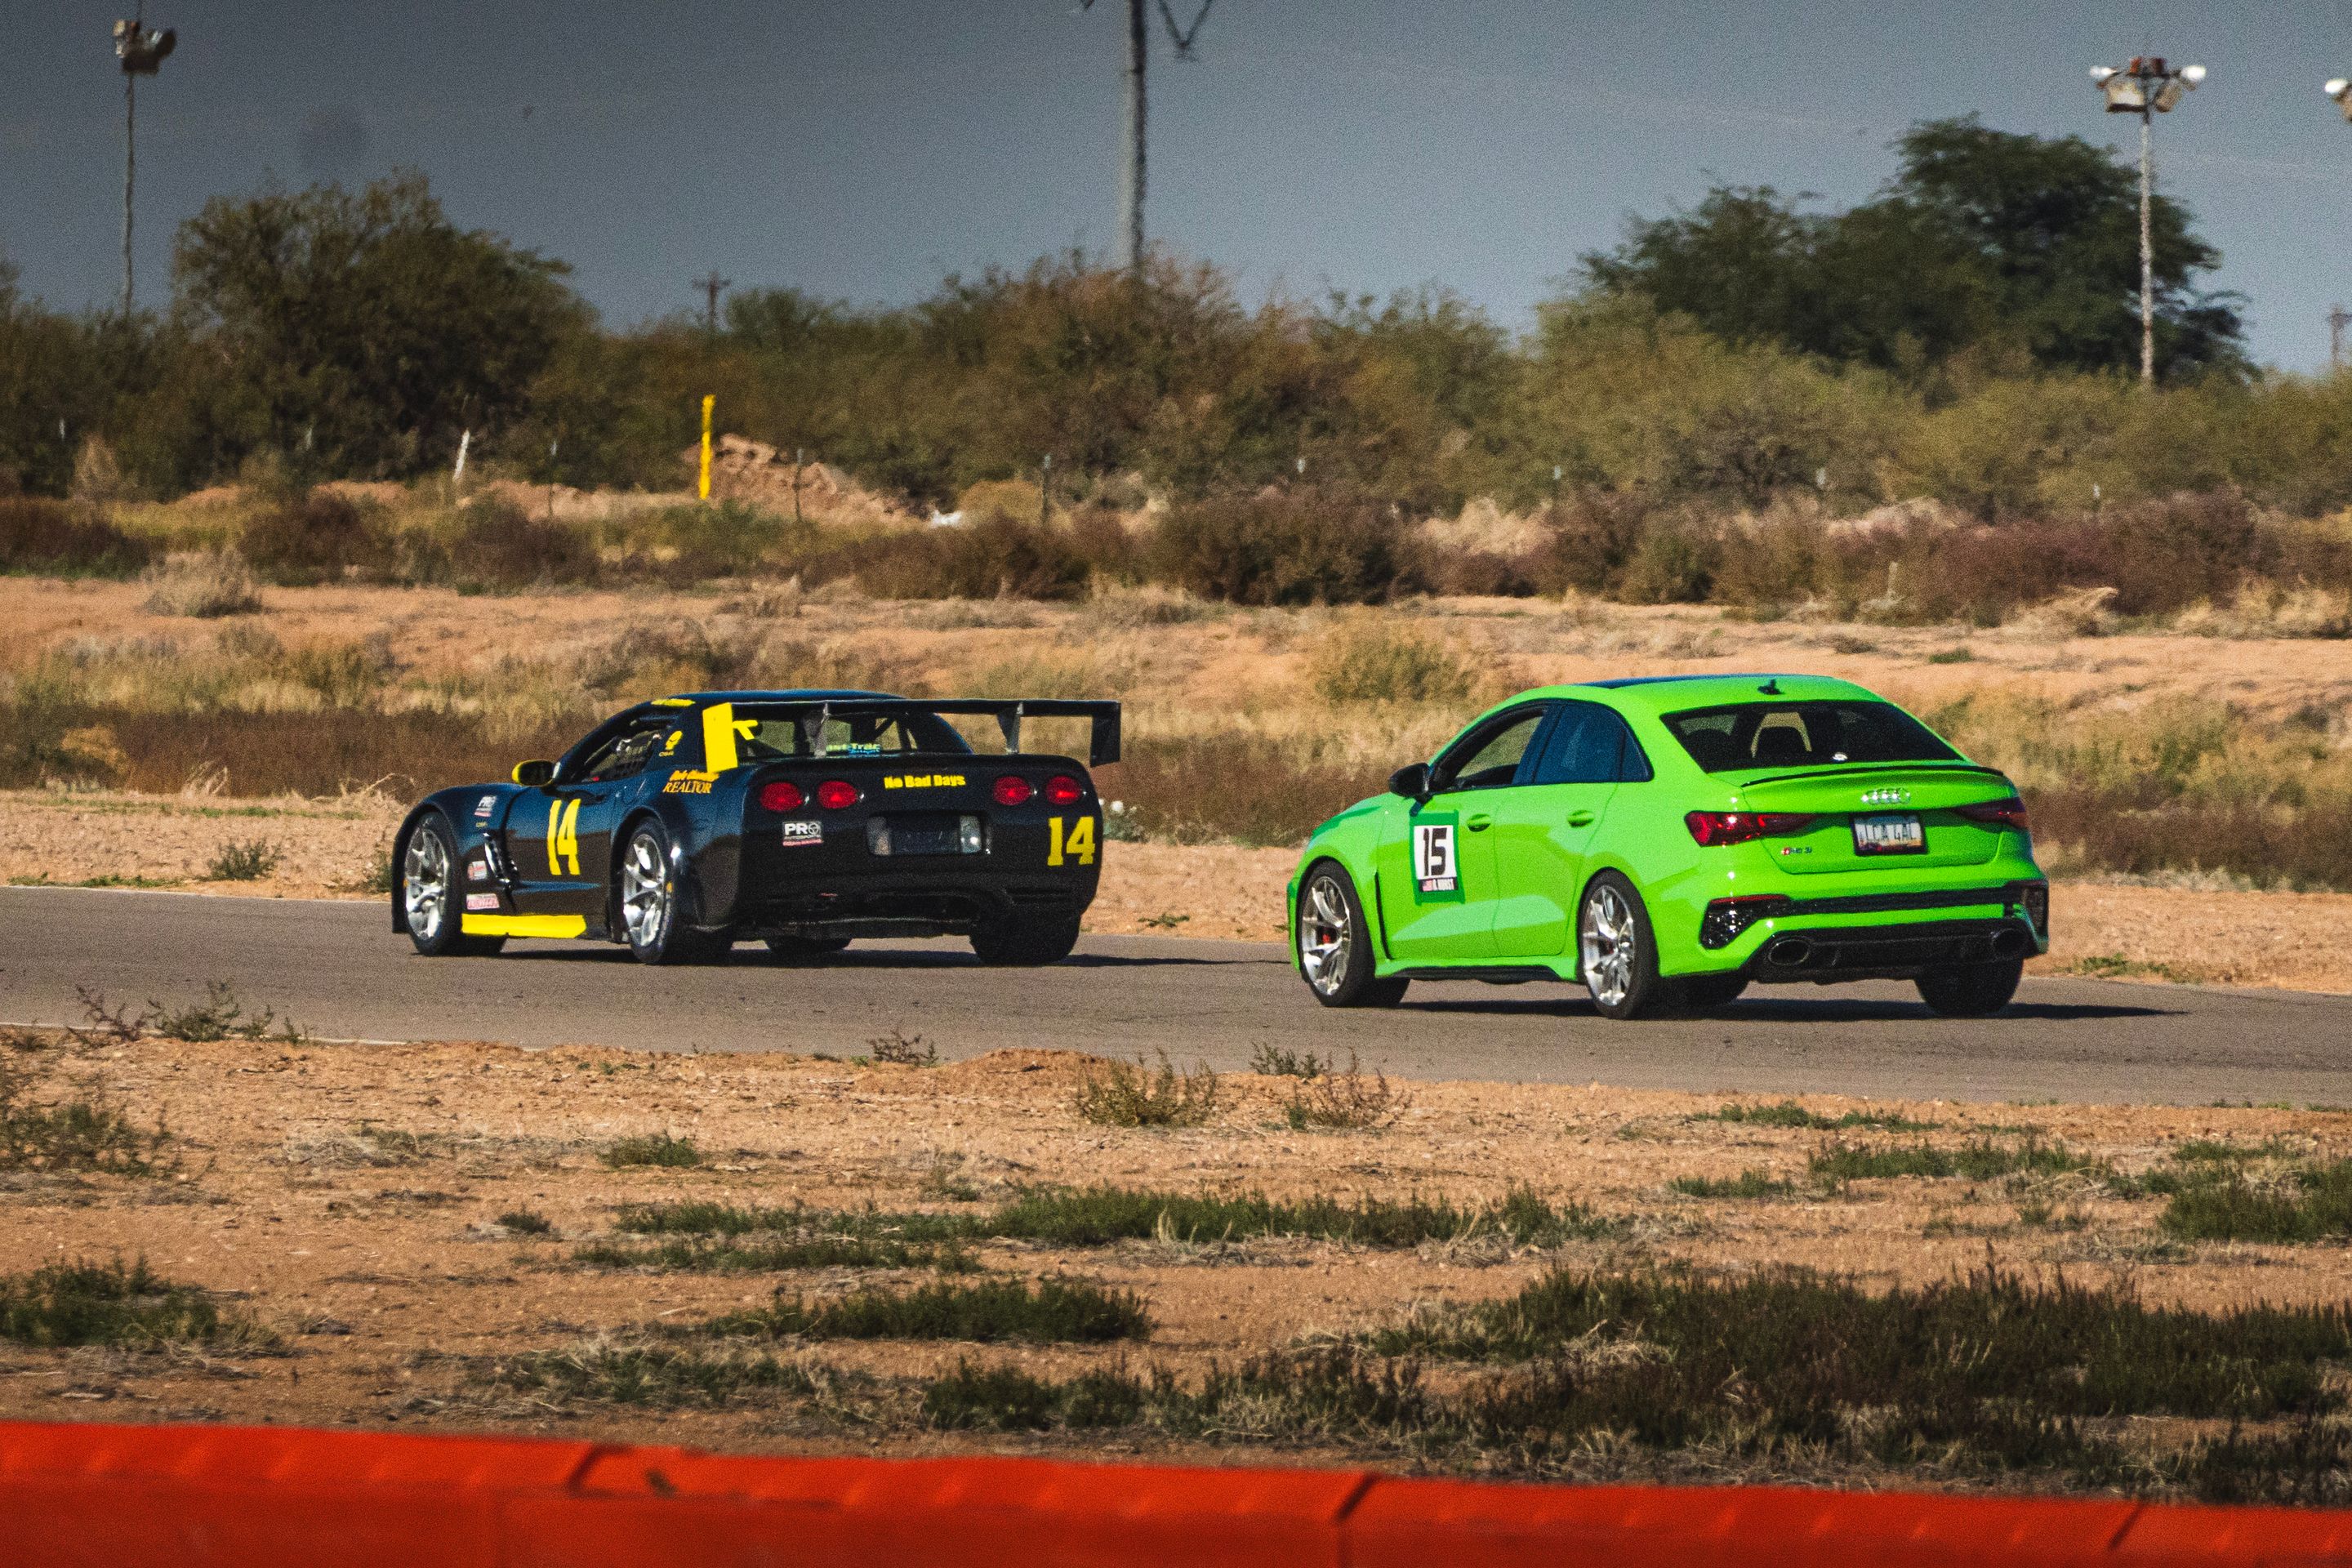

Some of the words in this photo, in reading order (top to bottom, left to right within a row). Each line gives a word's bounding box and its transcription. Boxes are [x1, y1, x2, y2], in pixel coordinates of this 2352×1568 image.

[662, 780, 712, 794] REALTOR
[884, 776, 903, 789] No
[904, 774, 932, 788] Bad
[933, 774, 966, 787] Days
[547, 798, 581, 876] 14
[1048, 816, 1095, 866] 14
[1423, 827, 1447, 876] 15
